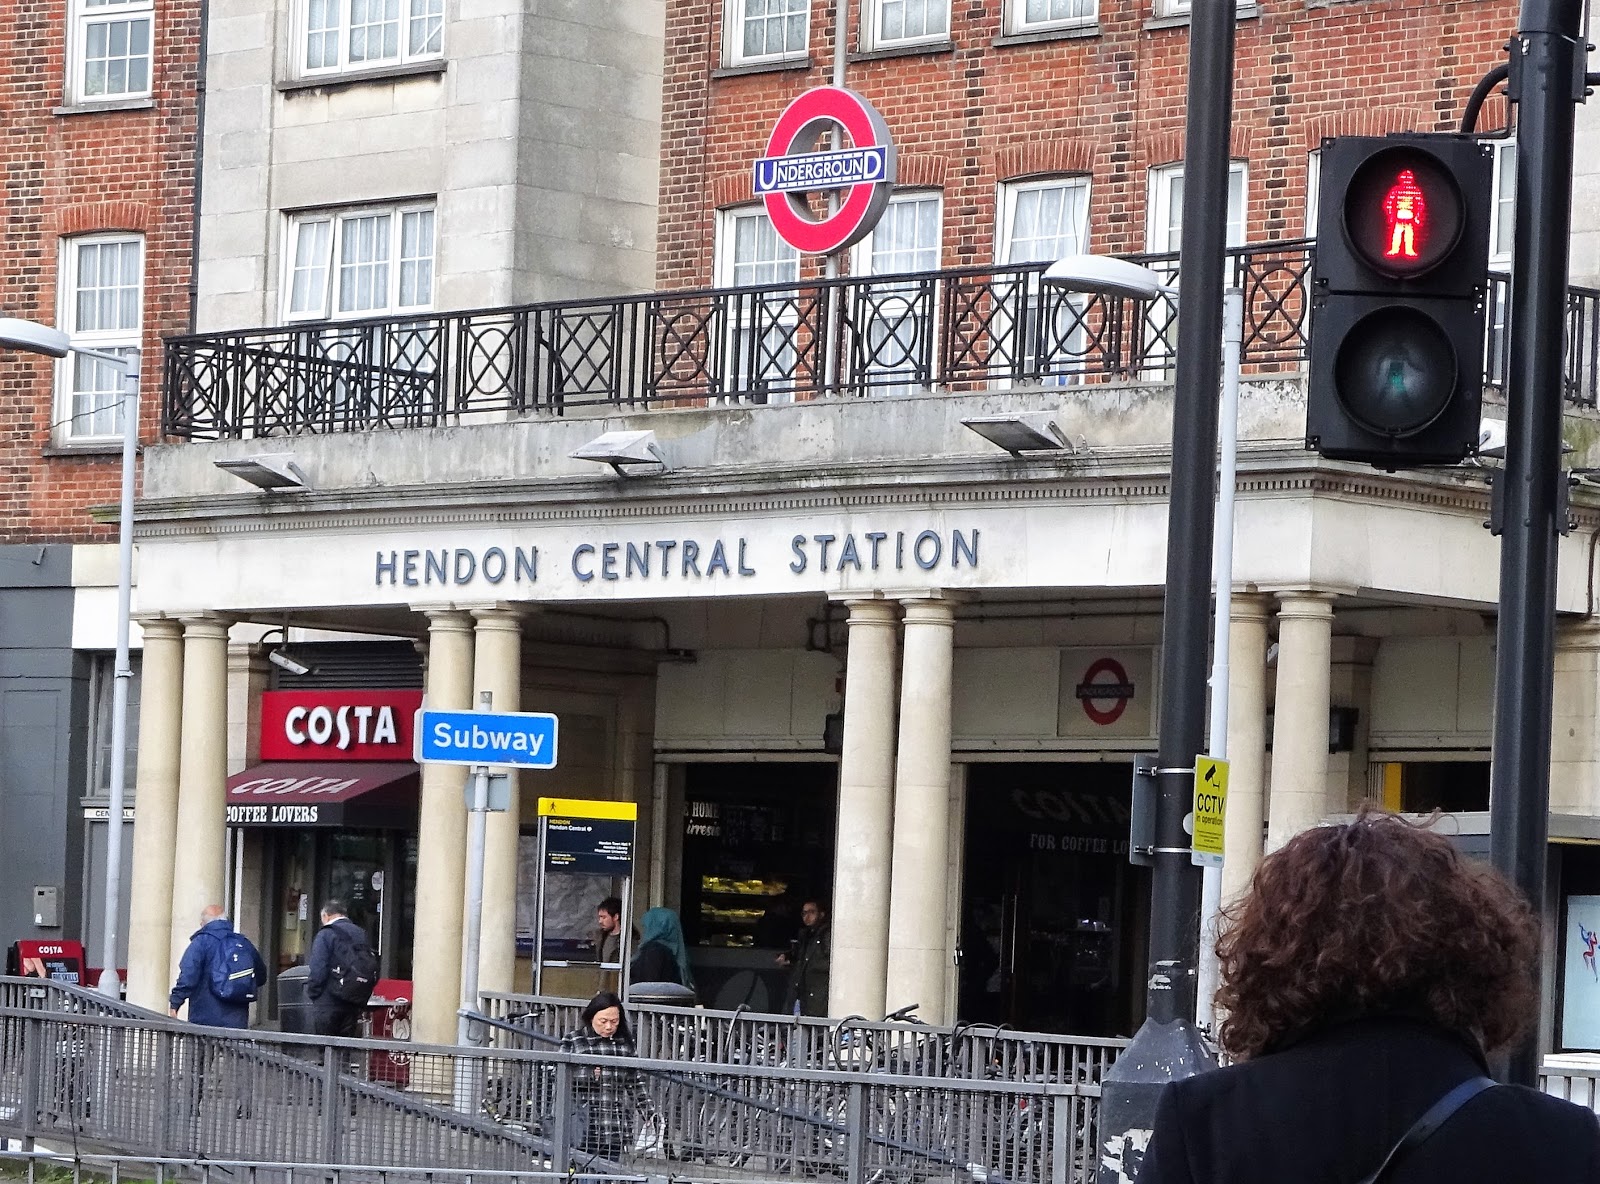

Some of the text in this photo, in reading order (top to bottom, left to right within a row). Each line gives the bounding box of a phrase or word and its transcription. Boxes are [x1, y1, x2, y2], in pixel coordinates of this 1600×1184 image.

[759, 150, 882, 190] UNDERGROUND
[375, 527, 980, 587] HENDON CENTRAL STATION
[285, 705, 397, 750] COSTA
[433, 722, 544, 757] Subway
[231, 776, 360, 795] COSTA
[271, 805, 318, 823] LOVERS
[1197, 793, 1225, 815] CCTV
[1030, 833, 1056, 850] FOR
[1061, 835, 1107, 854] COFFEE
[38, 946, 63, 955] COSTA
